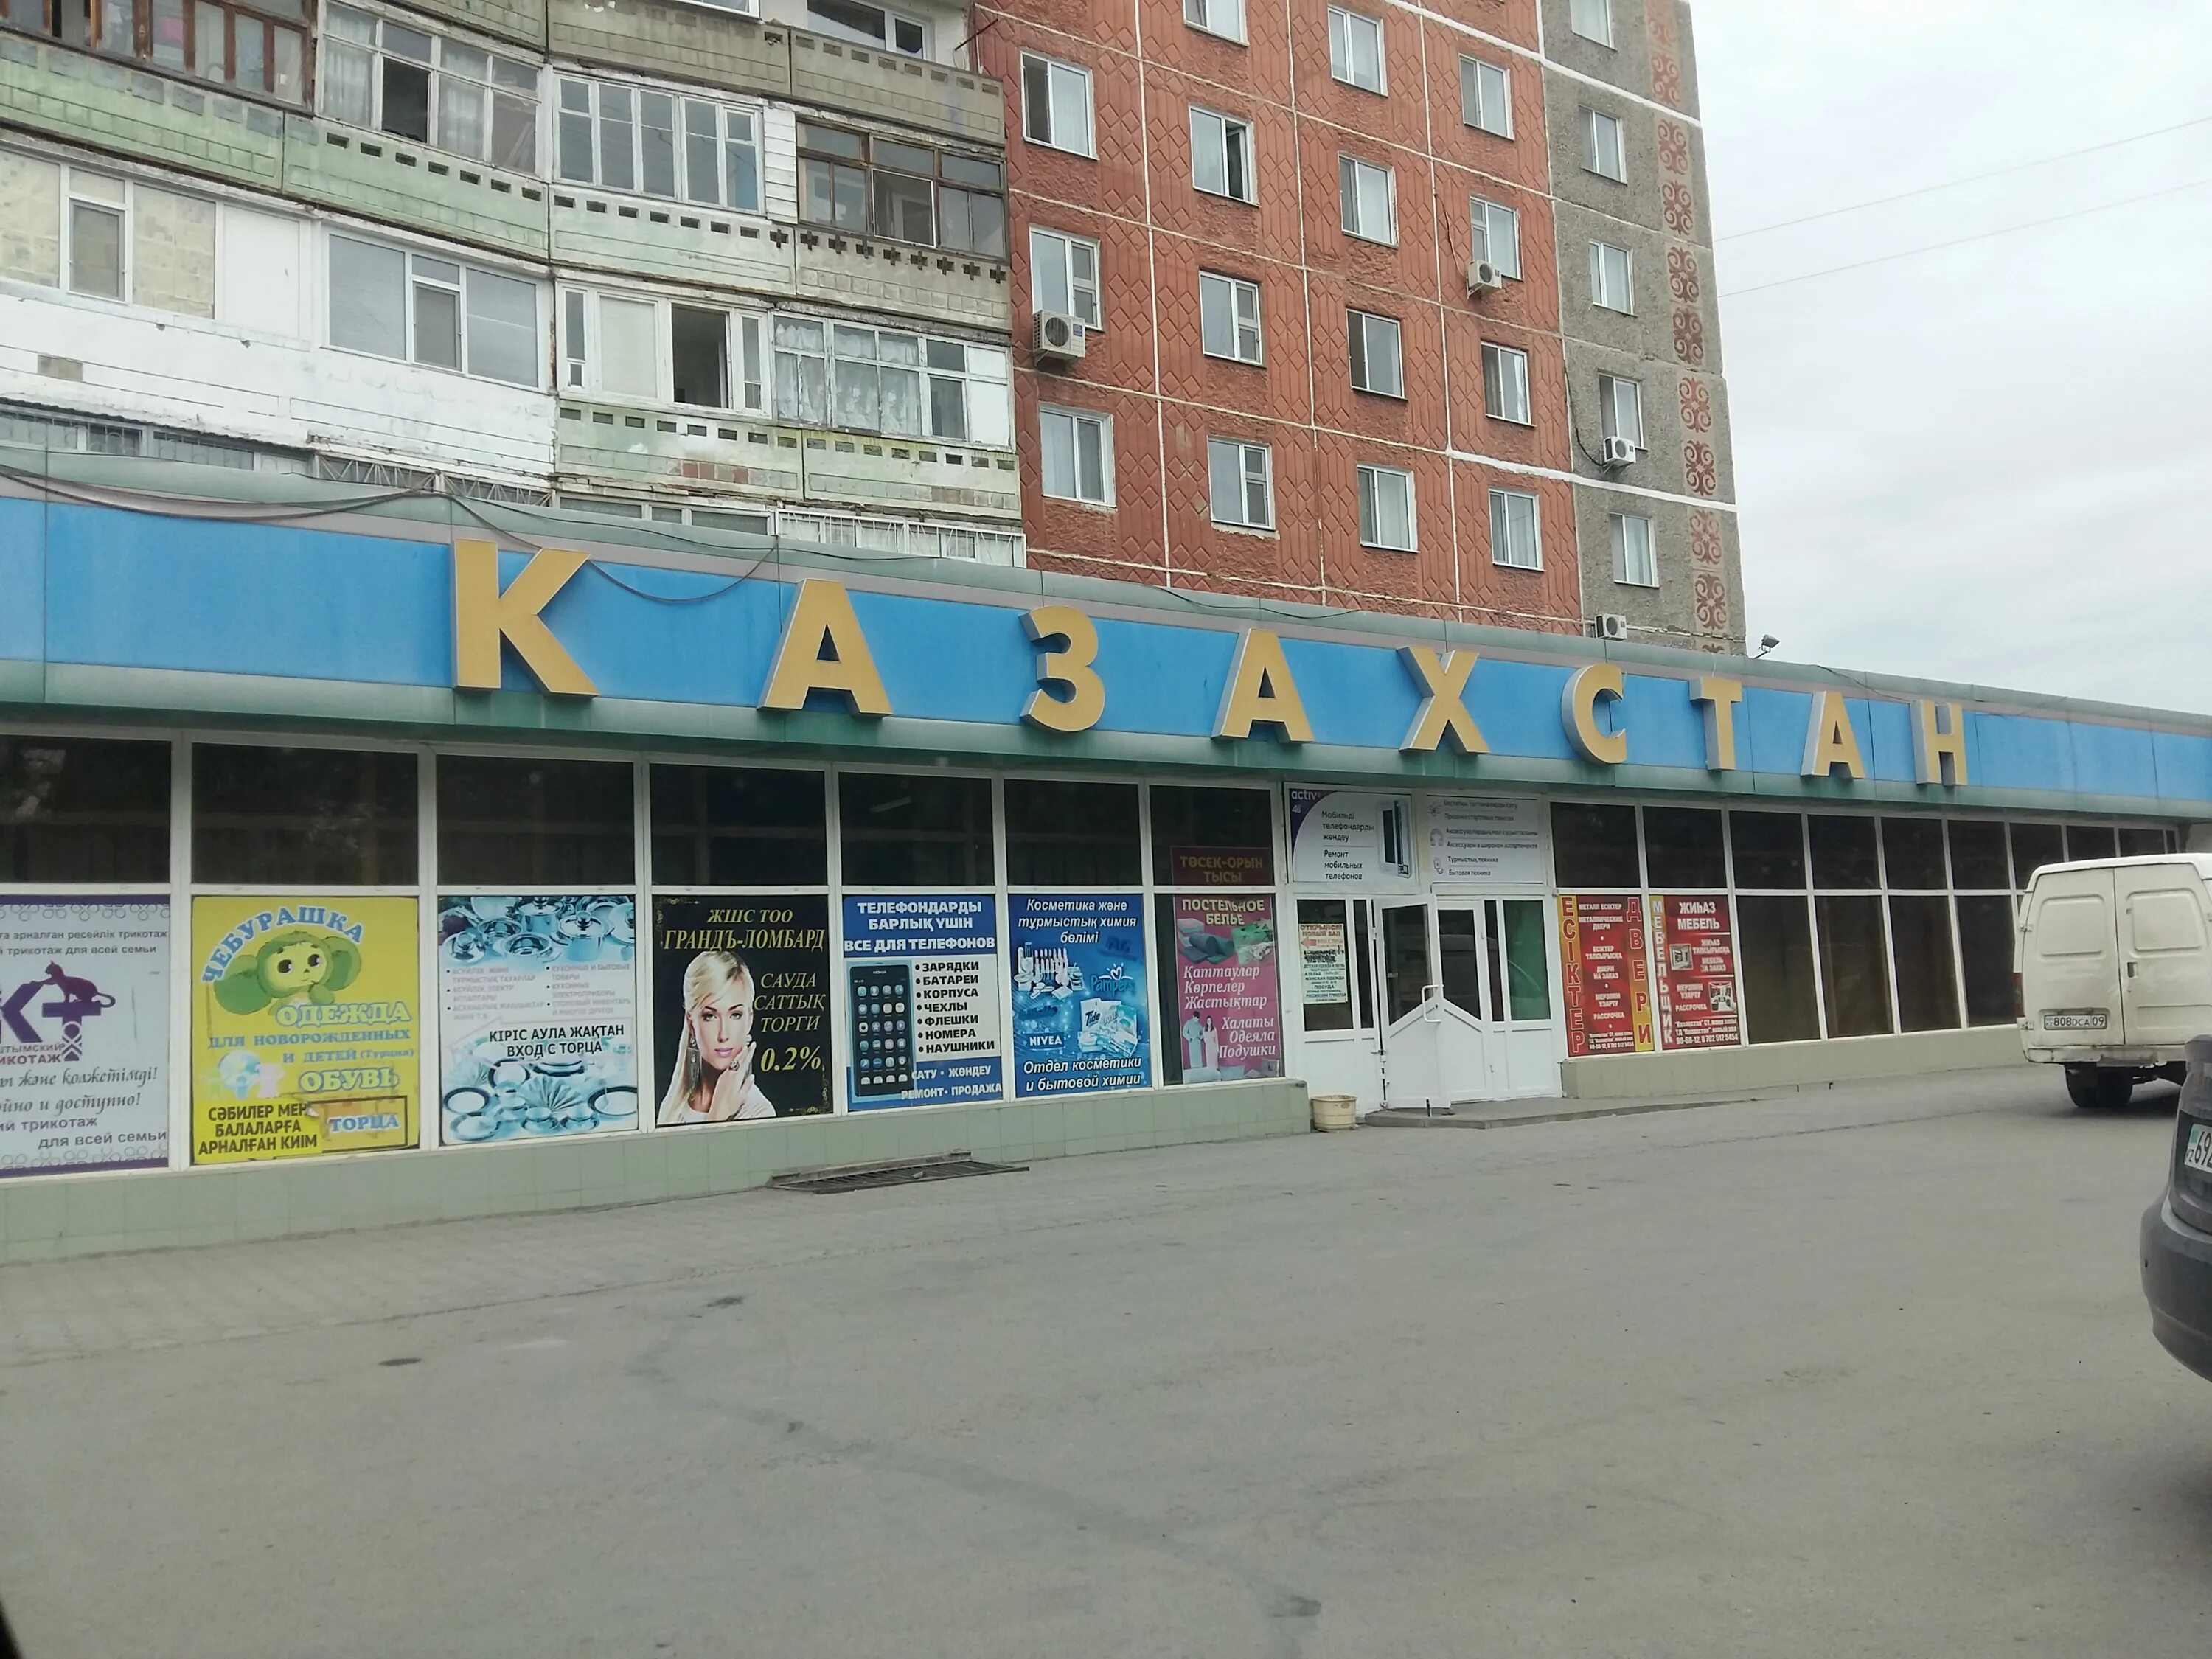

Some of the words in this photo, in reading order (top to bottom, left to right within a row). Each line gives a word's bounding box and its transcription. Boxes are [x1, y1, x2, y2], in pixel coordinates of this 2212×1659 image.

[452, 538, 1966, 786] КАЗАХСТАН
[1291, 790, 1318, 801] activ
[1321, 810, 1355, 820] Мобильді
[1322, 822, 1374, 832] телефондарды
[1322, 833, 1349, 842] жөндеу
[1324, 849, 1349, 858] Ремонт
[1180, 855, 1263, 870] ТӨСЕК-ОРЫН
[1324, 860, 1363, 869] мобильных
[1204, 871, 1242, 883] ТЫСЫ
[1325, 872, 1363, 881] телефонов
[857, 902, 981, 915] ТЕЛЕФОНДАРДЫ
[1026, 898, 1095, 911] Косметика
[1098, 900, 1127, 911] және
[1182, 898, 1265, 912] ПОСТЕЛЬНОЕ
[707, 909, 755, 923] ЖШС
[760, 909, 793, 923] ТОО
[1206, 913, 1245, 926] БЕЛЬЕ
[869, 918, 933, 931] БАРЛЫҚ
[936, 917, 973, 929] ҮШІН
[1018, 917, 1098, 930] тұрмыстық
[1099, 917, 1137, 928] химия
[1677, 917, 1719, 931] МЕБЕЛЬ
[68, 930, 115, 941] ресейлік
[118, 930, 167, 940] трикотаж
[664, 928, 825, 953] ГРАНДЪ-ЛОМБАРД
[1060, 931, 1099, 944] бөлімі
[7, 947, 62, 957] трикотаж
[65, 947, 88, 956] для
[91, 945, 118, 955] всей
[121, 945, 156, 954] семьи
[201, 905, 364, 983] ЧЕБУРАШКА
[844, 939, 872, 952] ВСЕ
[874, 939, 906, 953] ДЛЯ
[908, 937, 995, 950] ТЕЛЕФОНОВ
[922, 961, 979, 973] ЗАРЯДКИ
[1183, 965, 1260, 980] Қаттаулар
[1626, 897, 1652, 1044] ДВЕРИ
[1652, 900, 1673, 1044] МЕБЕЛЬЩИК
[760, 973, 816, 989] САУДА
[923, 975, 979, 986] БАТАРЕИ
[1561, 897, 1585, 1053] ЕСІКТЕР
[924, 988, 979, 999] КОРПУСА
[1184, 981, 1245, 995] Көрпелер
[754, 993, 826, 1012] САТТЫҚ
[924, 1002, 967, 1012] ЧЕХЛЫ
[1185, 995, 1267, 1011] Жастықтар
[1675, 1004, 1707, 1012] РАССРОЧКА
[275, 1001, 411, 1026] ОДЕЖДА
[925, 1015, 978, 1026] ФЛЕШКИ
[1085, 1010, 1101, 1027] Tide
[761, 1015, 820, 1032] ТОРГИ
[1221, 1016, 1274, 1030] Халаты
[2053, 1017, 2090, 1026] 808DCA
[2093, 1017, 2104, 1026] 09
[208, 1036, 245, 1048] ДЛЯ
[254, 1029, 410, 1046] НОВОРОЖДЕННЫХ
[489, 1029, 528, 1042] КІРІС
[531, 1027, 566, 1040] АУЛА
[570, 1025, 624, 1039] ЖАҚТАН
[925, 1029, 976, 1040] НОМЕРА
[1029, 1035, 1062, 1046] NIVEA
[1229, 1030, 1275, 1044] Одеяла
[1716, 1034, 1725, 1042] 512
[507, 1043, 543, 1058] ВХОД
[547, 1043, 556, 1054] С
[560, 1041, 602, 1055] ТОРЦА
[926, 1041, 995, 1054] НАУШНИКИ
[1219, 1043, 1276, 1060] Подушки
[282, 1052, 294, 1063] И
[303, 1048, 357, 1063] ДЕТЕЙ
[760, 1046, 821, 1072] 0.2%
[911, 1069, 937, 1080] САТУ
[949, 1065, 992, 1077] ЖӨНДЕУ
[1023, 1060, 1070, 1074] Отдел
[1072, 1058, 1142, 1071] косметики
[18, 1069, 57, 1087] және
[299, 1067, 400, 1093] ОБУВЬ
[1026, 1082, 1034, 1092] и
[1037, 1074, 1099, 1090] бытовой
[1102, 1074, 1141, 1086] химии
[951, 1082, 1003, 1096] ПРОДАЖА
[39, 1101, 49, 1111] и
[53, 1093, 140, 1117] доступно!
[208, 1105, 274, 1121] СӘБИЛЕР
[21, 1116, 97, 1133] трикотаж
[215, 1119, 301, 1138] БАЛАЛАРҒА
[327, 1114, 400, 1133] ТОРЦА
[38, 1138, 69, 1150] для
[75, 1133, 112, 1146] всей
[118, 1131, 167, 1144] семьи
[198, 1138, 277, 1155] АРНАЛҒАН
[280, 1134, 317, 1150] КИІМ
